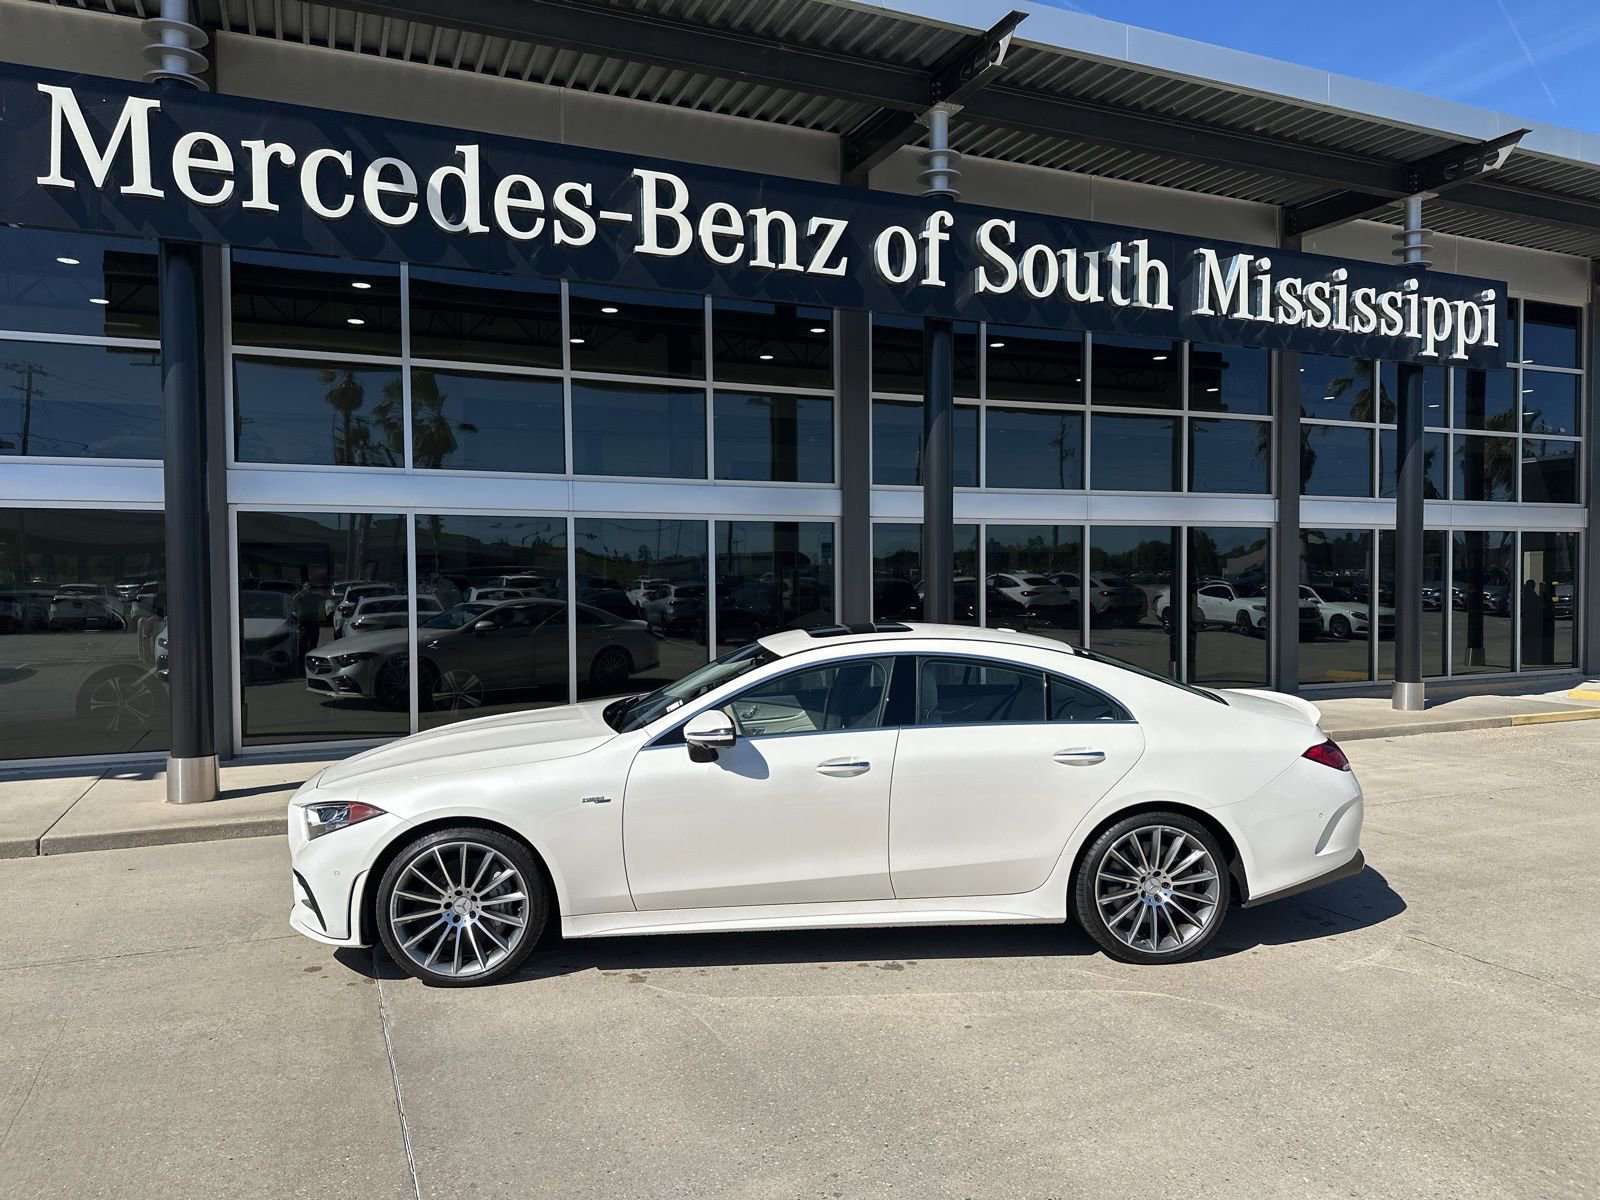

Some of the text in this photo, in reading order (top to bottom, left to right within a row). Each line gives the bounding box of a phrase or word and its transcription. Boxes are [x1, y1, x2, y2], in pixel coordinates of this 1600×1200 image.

[36, 83, 1499, 361] Mercedes-Benz of South Mississippi
